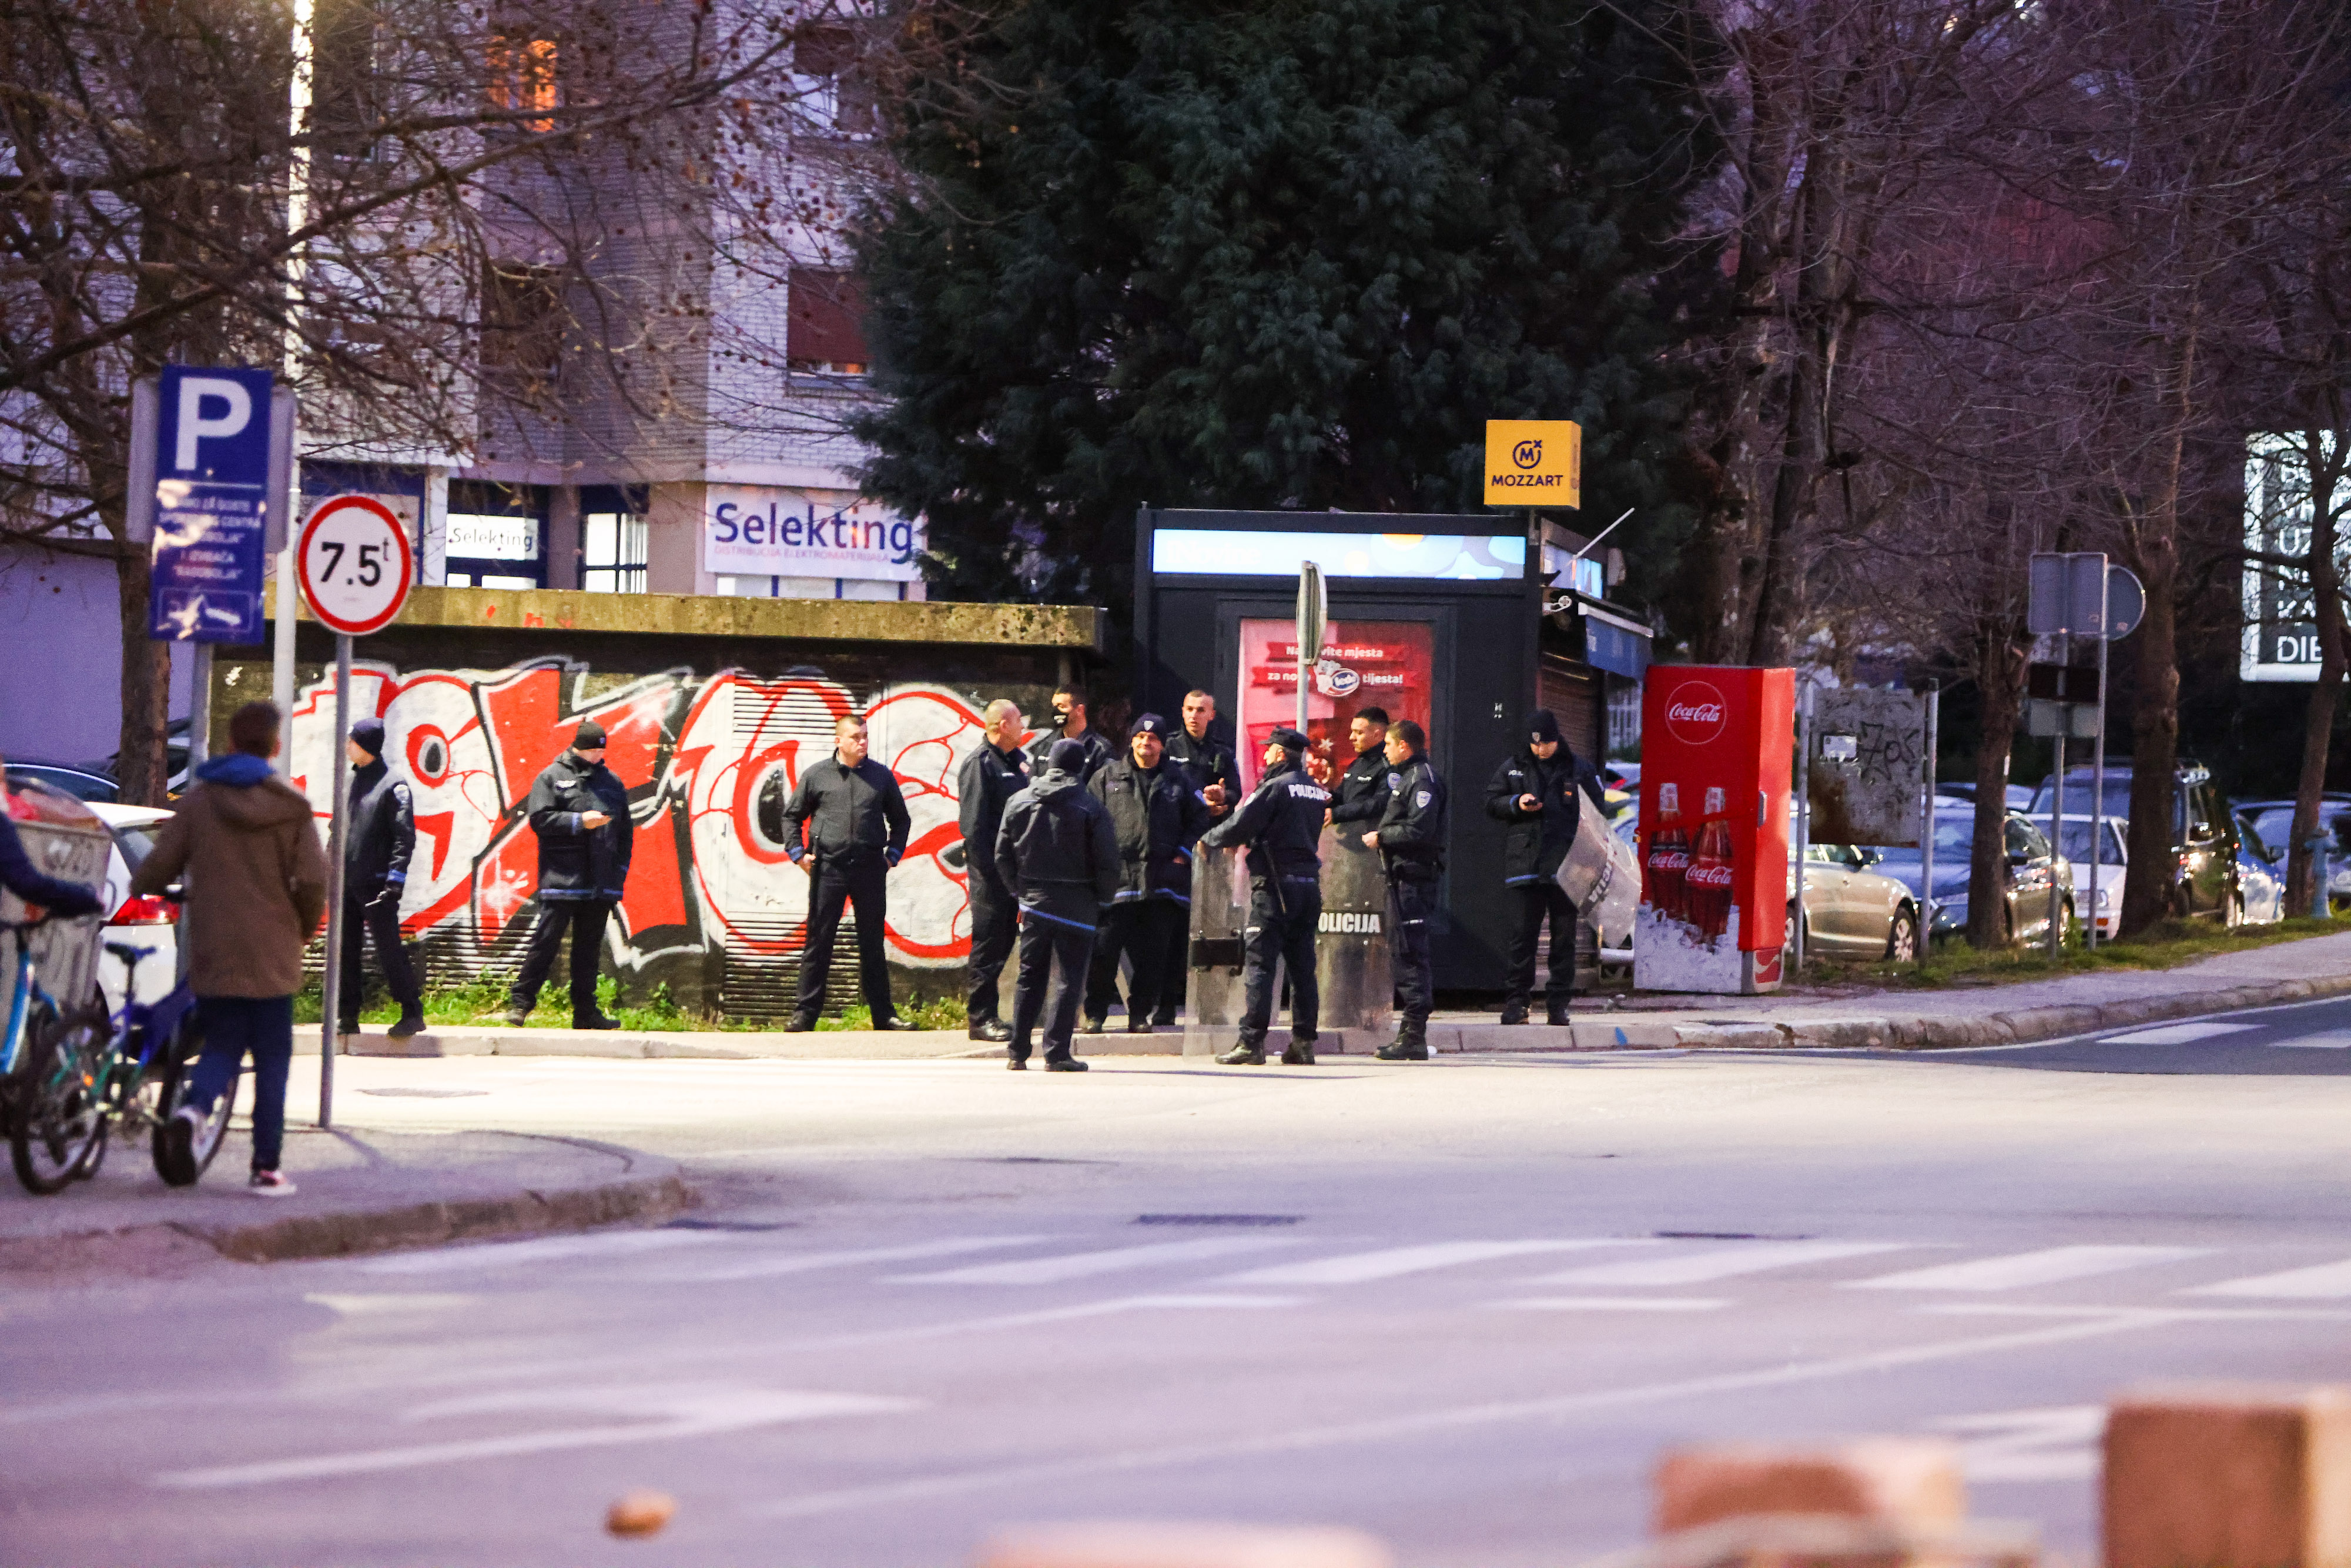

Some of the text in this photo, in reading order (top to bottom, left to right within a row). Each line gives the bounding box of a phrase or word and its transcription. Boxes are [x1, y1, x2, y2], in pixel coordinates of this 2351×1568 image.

[175, 377, 252, 470] P
[1491, 474, 1563, 487] MOZZART
[453, 527, 533, 552] Selekting
[715, 501, 913, 564] Selekting
[1344, 646, 1384, 659] mjesta
[1268, 672, 1281, 681] za
[1318, 912, 1381, 933] OLICIJA
